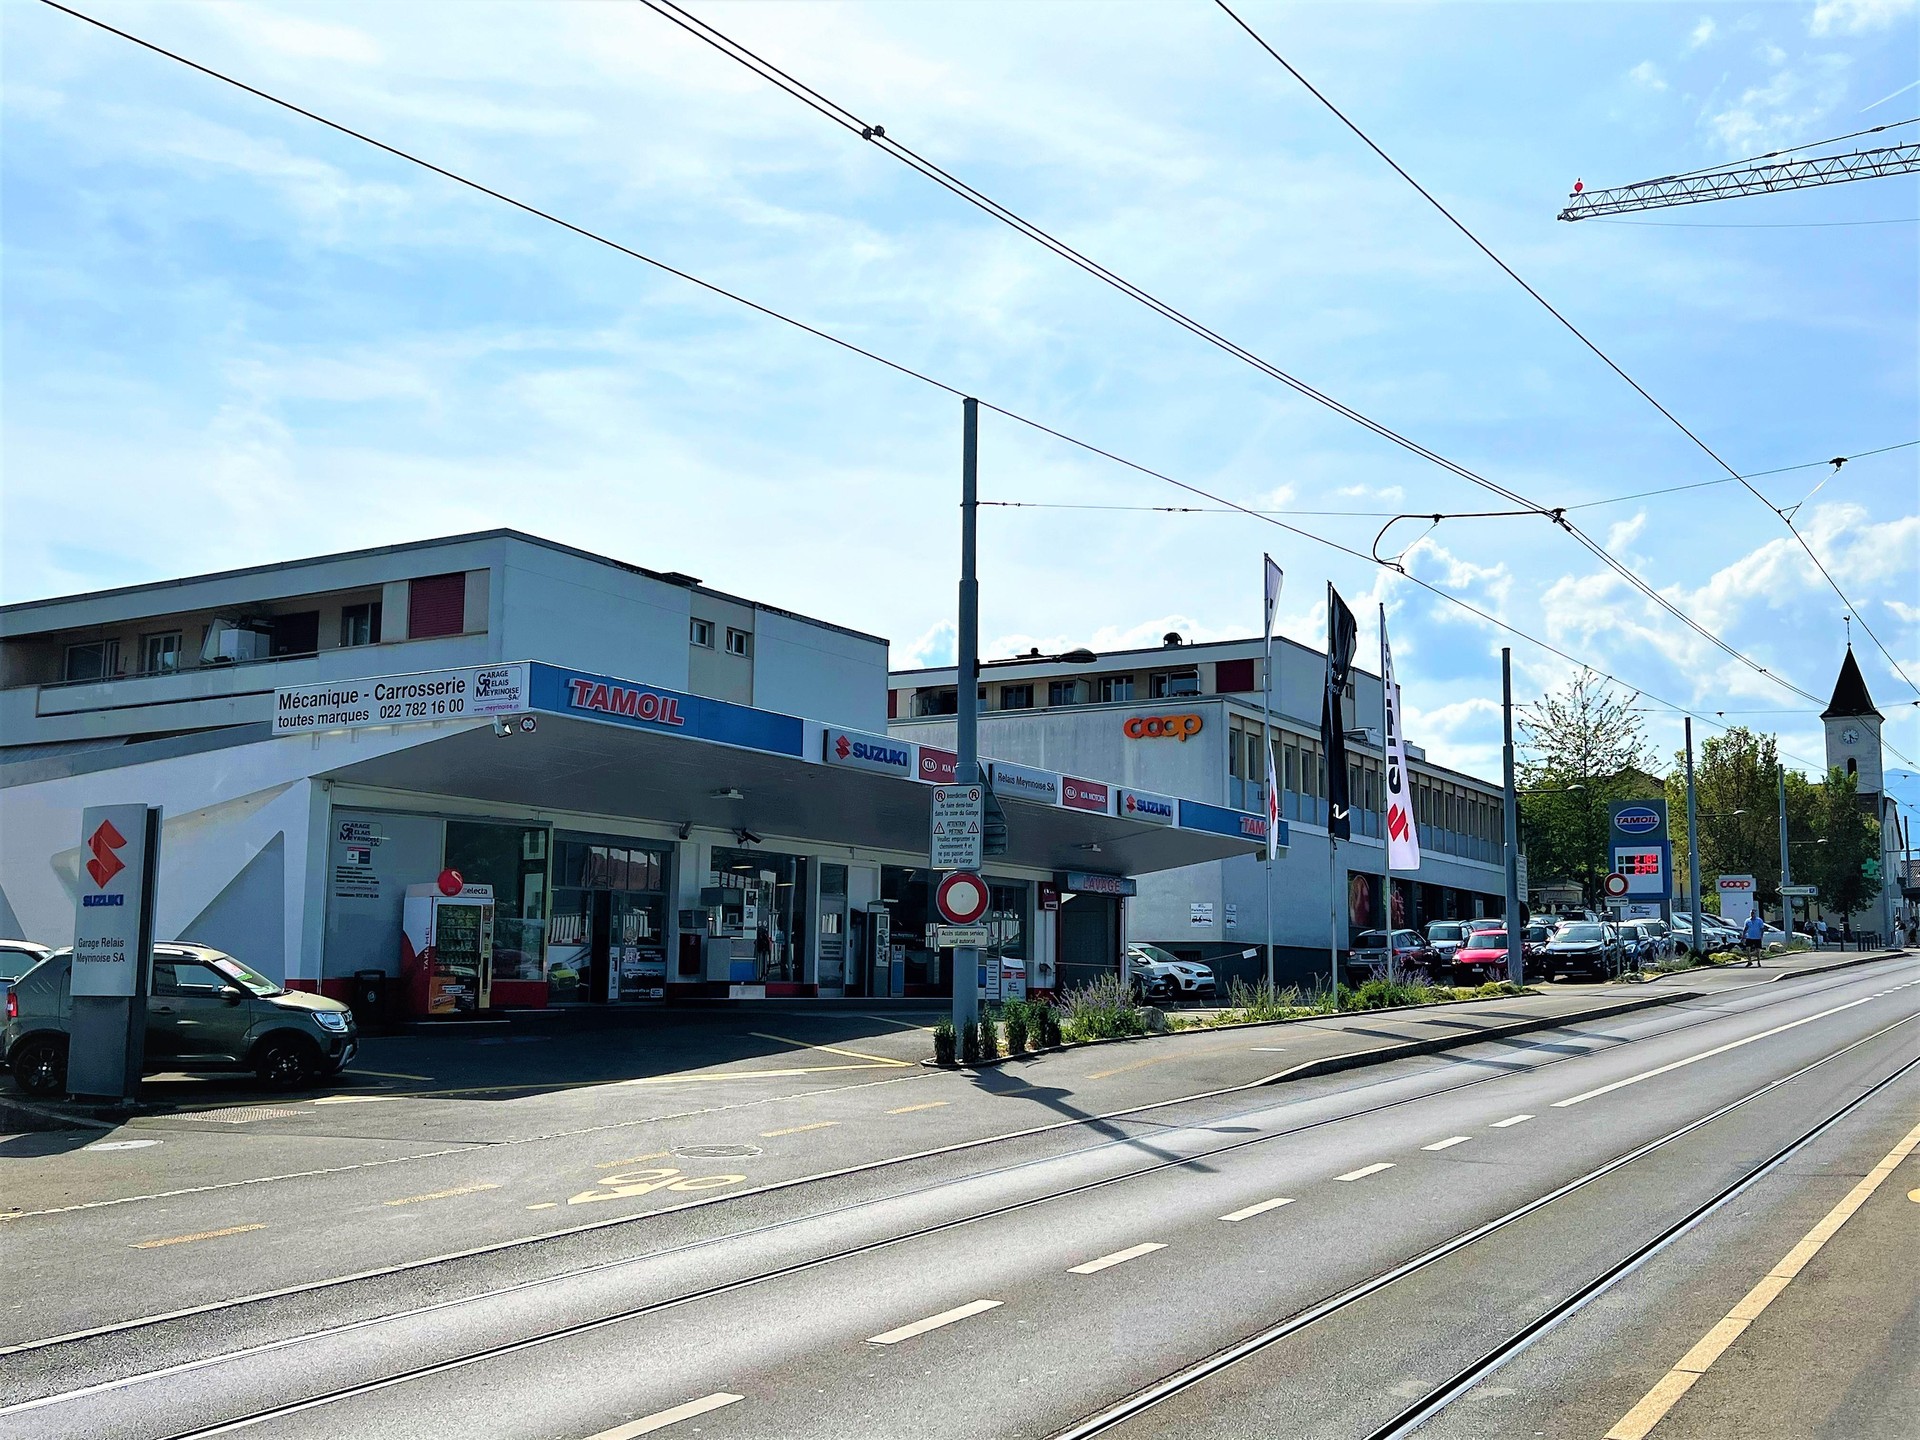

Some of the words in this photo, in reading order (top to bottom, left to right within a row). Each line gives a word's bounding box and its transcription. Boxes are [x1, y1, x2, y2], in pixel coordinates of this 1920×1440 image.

[478, 670, 509, 686] GARAGE
[484, 679, 509, 689] RELAIS
[279, 689, 359, 710] Mécanique
[375, 677, 466, 701] Carrosserie
[476, 686, 520, 697] MEYRINOISE
[570, 678, 685, 726] TAMOIL
[278, 714, 314, 728] toutes
[317, 710, 370, 725] marques
[379, 704, 401, 719] 022
[405, 702, 427, 717] 782
[431, 700, 445, 715] 16
[448, 698, 464, 713] 00
[1123, 714, 1203, 742] coop
[852, 742, 908, 767] SUZUKI
[942, 764, 951, 773] KIA
[998, 772, 1015, 785] Relais
[1016, 776, 1046, 790] Meyrinoise
[1046, 782, 1055, 792] SA
[1136, 799, 1171, 817] SUZUKI
[1616, 816, 1658, 824] TAMOIL
[1083, 876, 1120, 894] LAVAGE
[1720, 881, 1751, 889] coop
[83, 895, 124, 907] SUZUKI
[78, 938, 99, 950] Garage
[101, 937, 124, 948] Relais
[76, 953, 111, 965] Meyrinoise
[113, 952, 125, 962] SA
